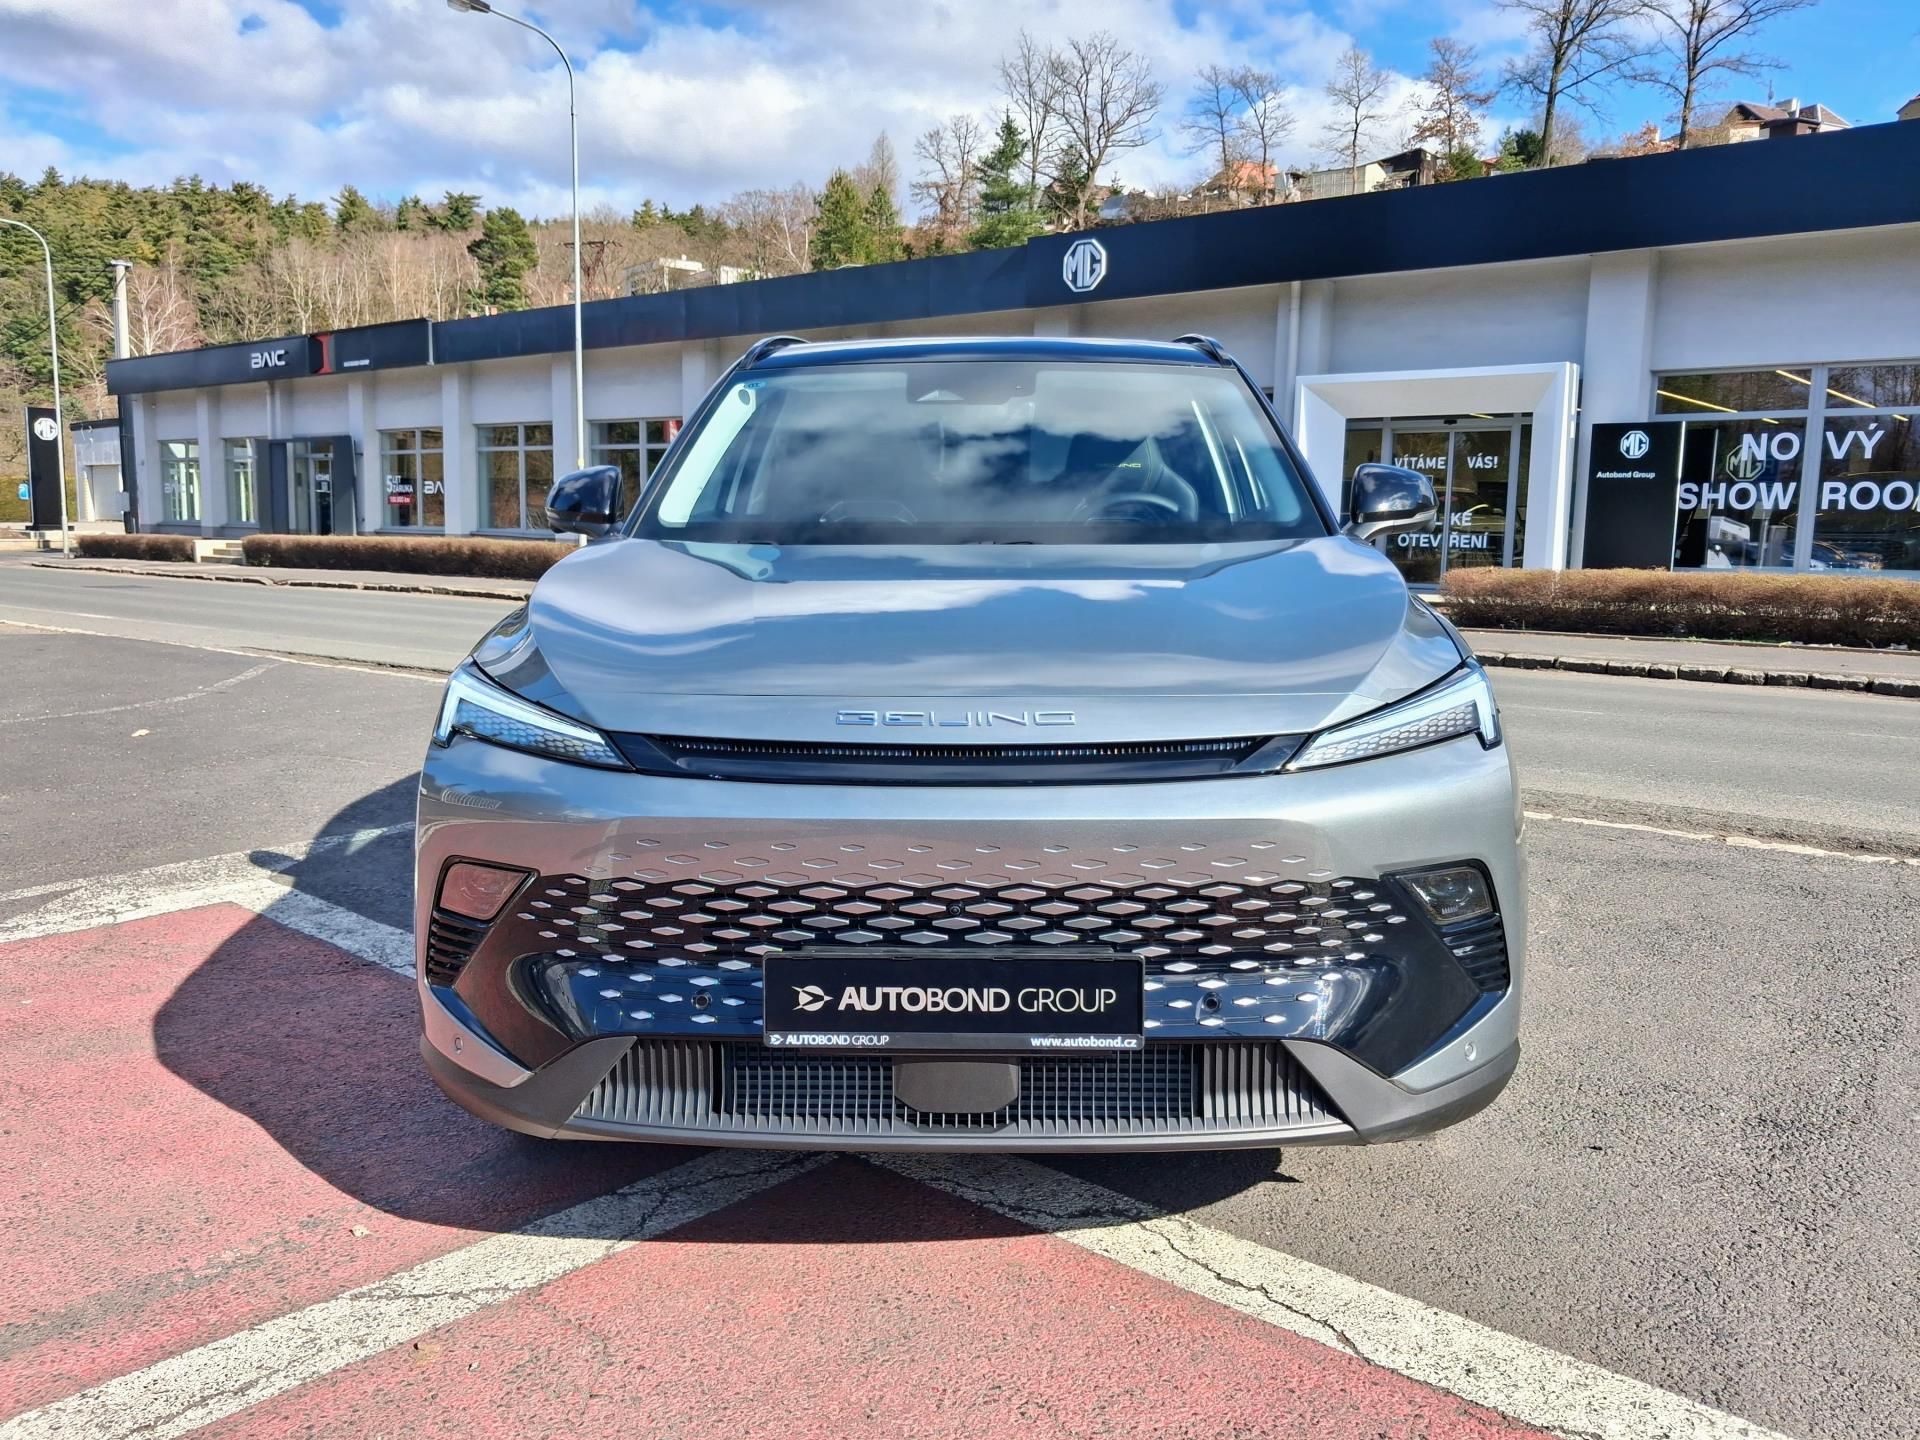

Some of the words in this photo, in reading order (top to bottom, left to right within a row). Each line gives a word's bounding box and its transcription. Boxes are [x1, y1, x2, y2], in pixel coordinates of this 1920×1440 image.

[1066, 243, 1102, 288] MG
[251, 349, 286, 369] BAIC
[1621, 432, 1648, 456] MG
[1395, 453, 1447, 470] VÍTÁME
[1467, 453, 1499, 469] VÁS!
[1596, 471, 1632, 479] Autobond
[1633, 471, 1656, 480] Group
[424, 481, 445, 495] BA
[1679, 482, 1797, 510] SHOW
[1821, 481, 1920, 512] ROO
[837, 986, 1010, 1013] AUTOBOND
[1017, 987, 1117, 1013] GROUP
[785, 1034, 850, 1046] AUTOBOND
[851, 1035, 889, 1046] GROUP
[1030, 1036, 1137, 1048] www.autobond.cz
